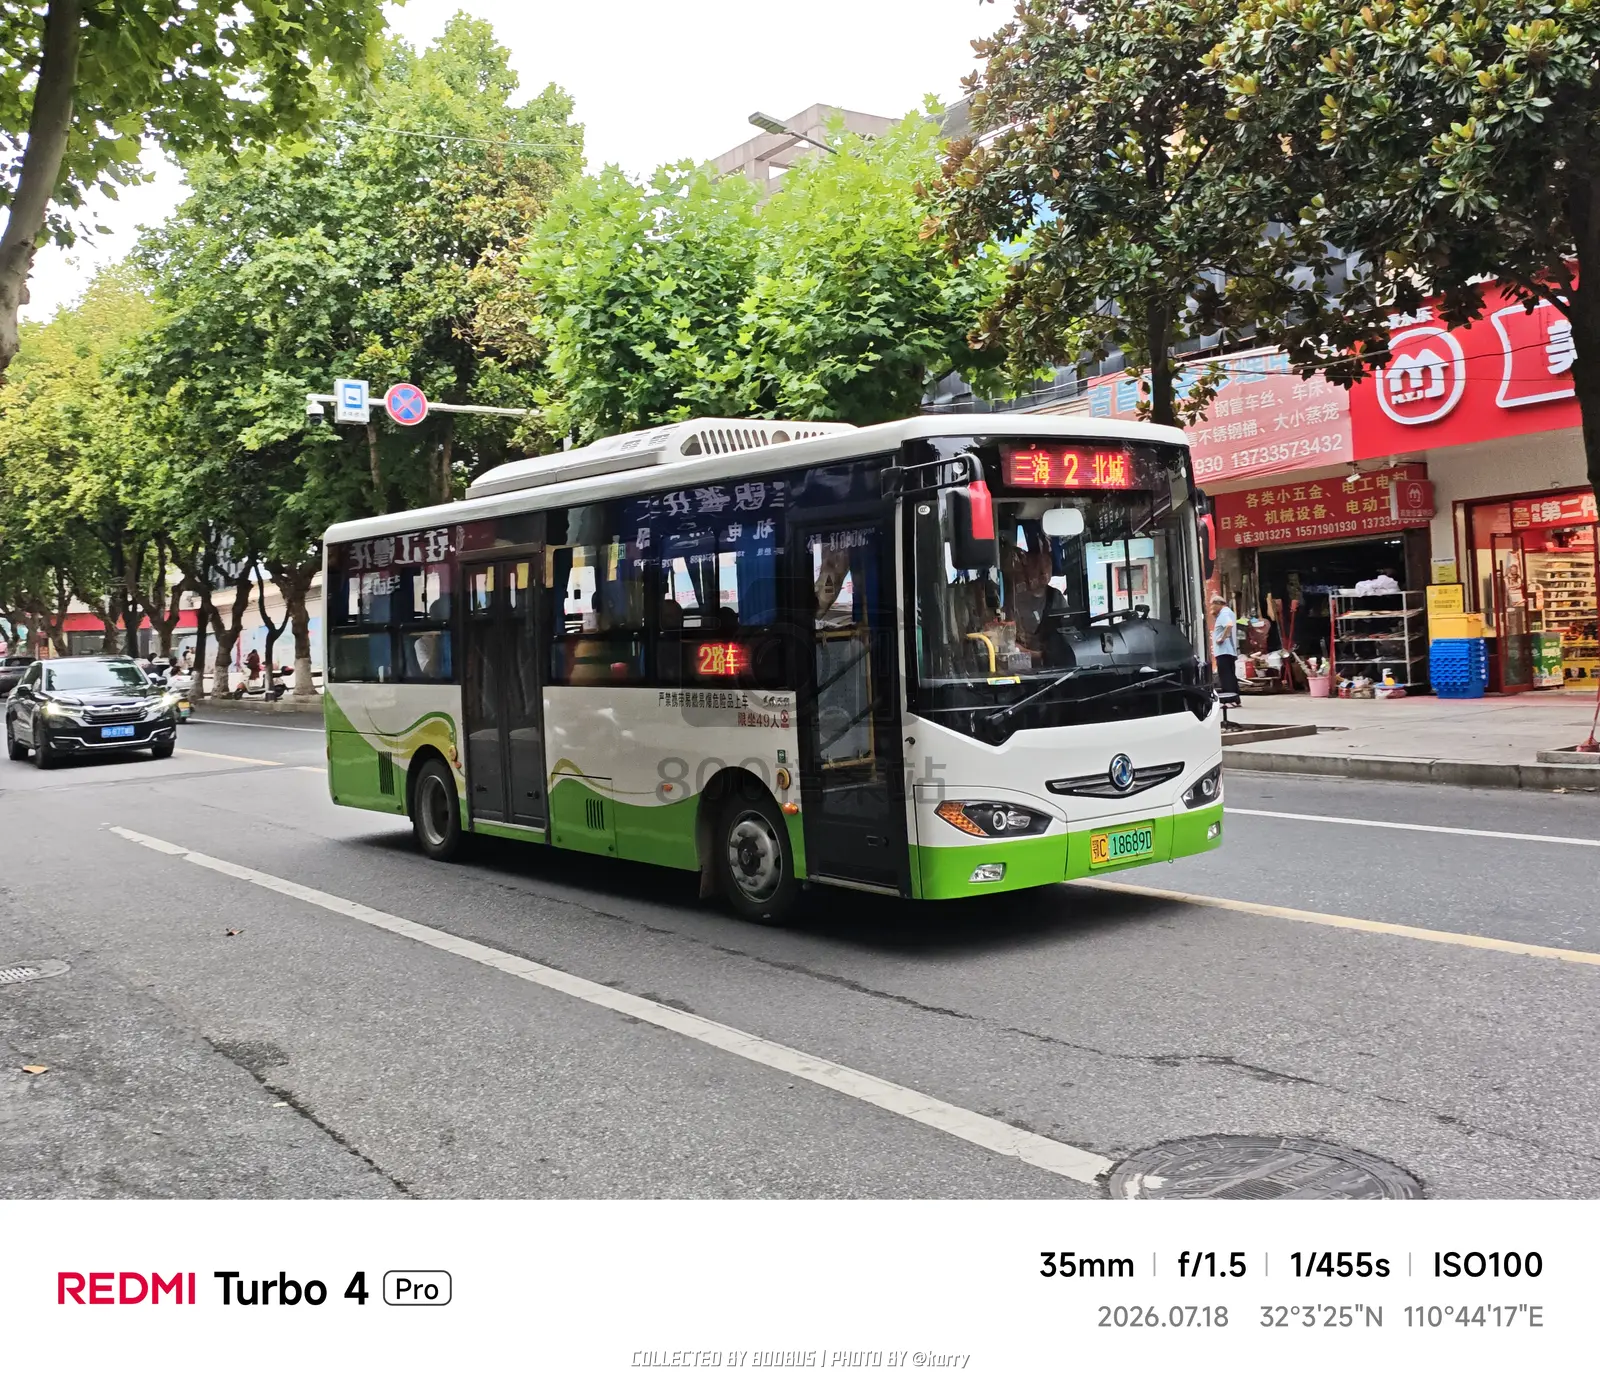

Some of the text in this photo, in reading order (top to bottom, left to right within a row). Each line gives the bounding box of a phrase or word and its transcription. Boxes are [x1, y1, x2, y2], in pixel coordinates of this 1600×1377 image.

[1231, 434, 1343, 469] 13733573432
[1014, 453, 1125, 486] 三海 2 北城
[1296, 519, 1357, 538] 15571901930
[700, 644, 739, 675] 2路车
[737, 711, 780, 729] 限坐49人
[1092, 830, 1152, 860] 鄂C 18689D
